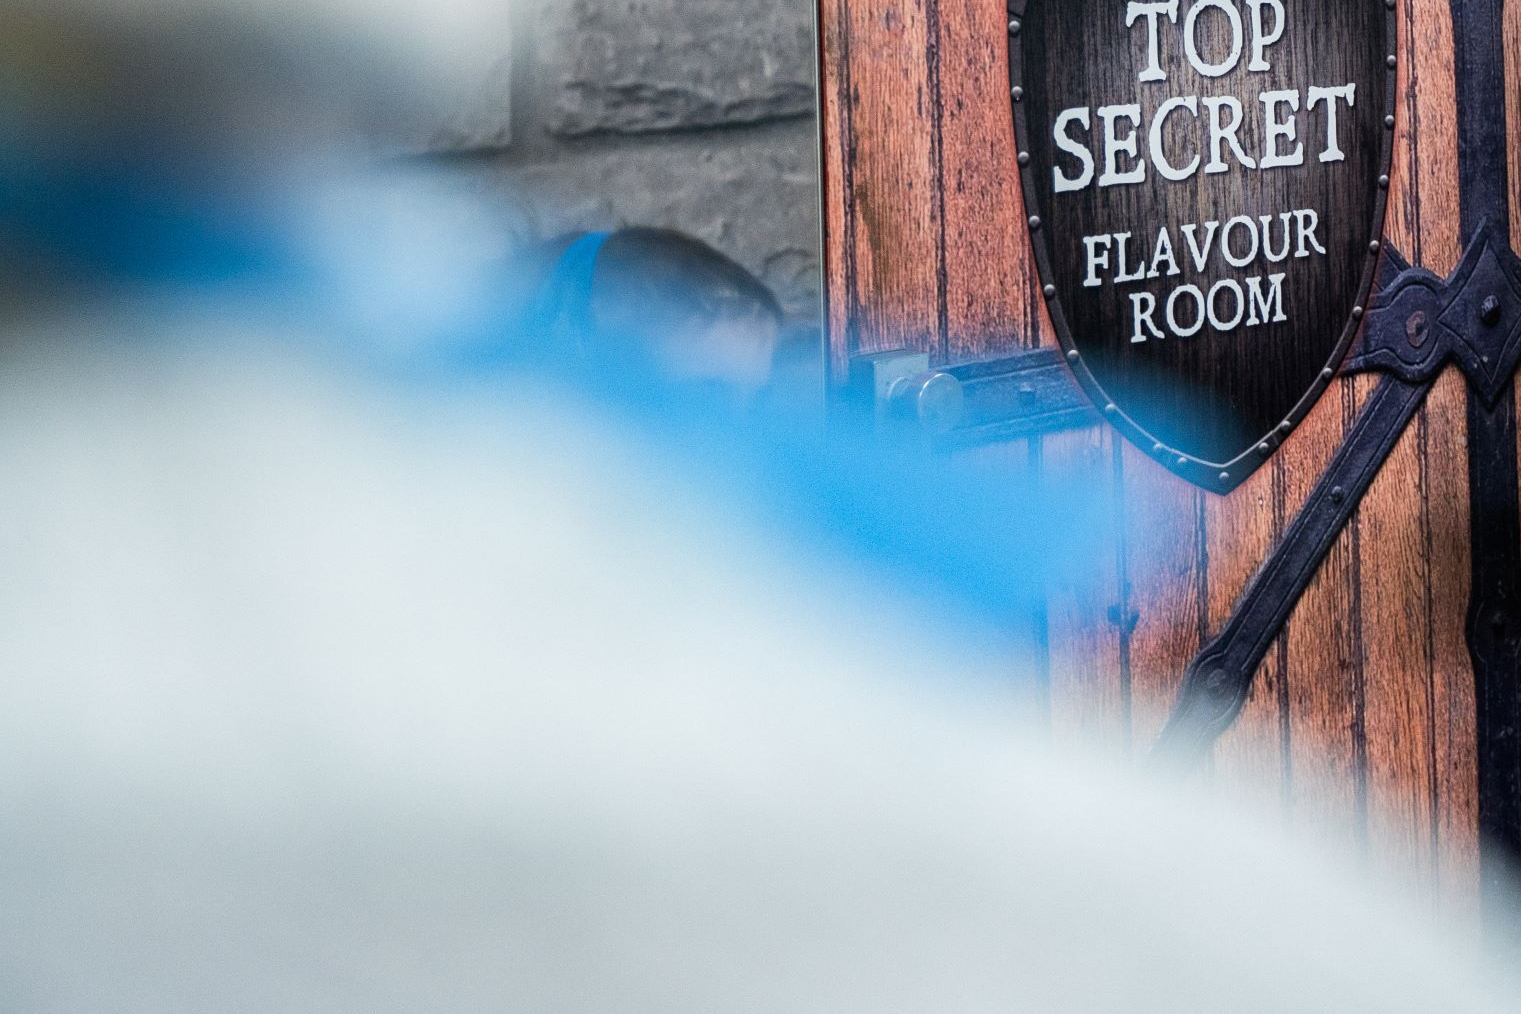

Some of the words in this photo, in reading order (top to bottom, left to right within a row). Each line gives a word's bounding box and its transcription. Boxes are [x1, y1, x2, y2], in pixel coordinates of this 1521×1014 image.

[1052, 83, 1356, 193] SECRET
[1082, 209, 1326, 287] FLAVOUR
[1129, 273, 1288, 343] ROOM
